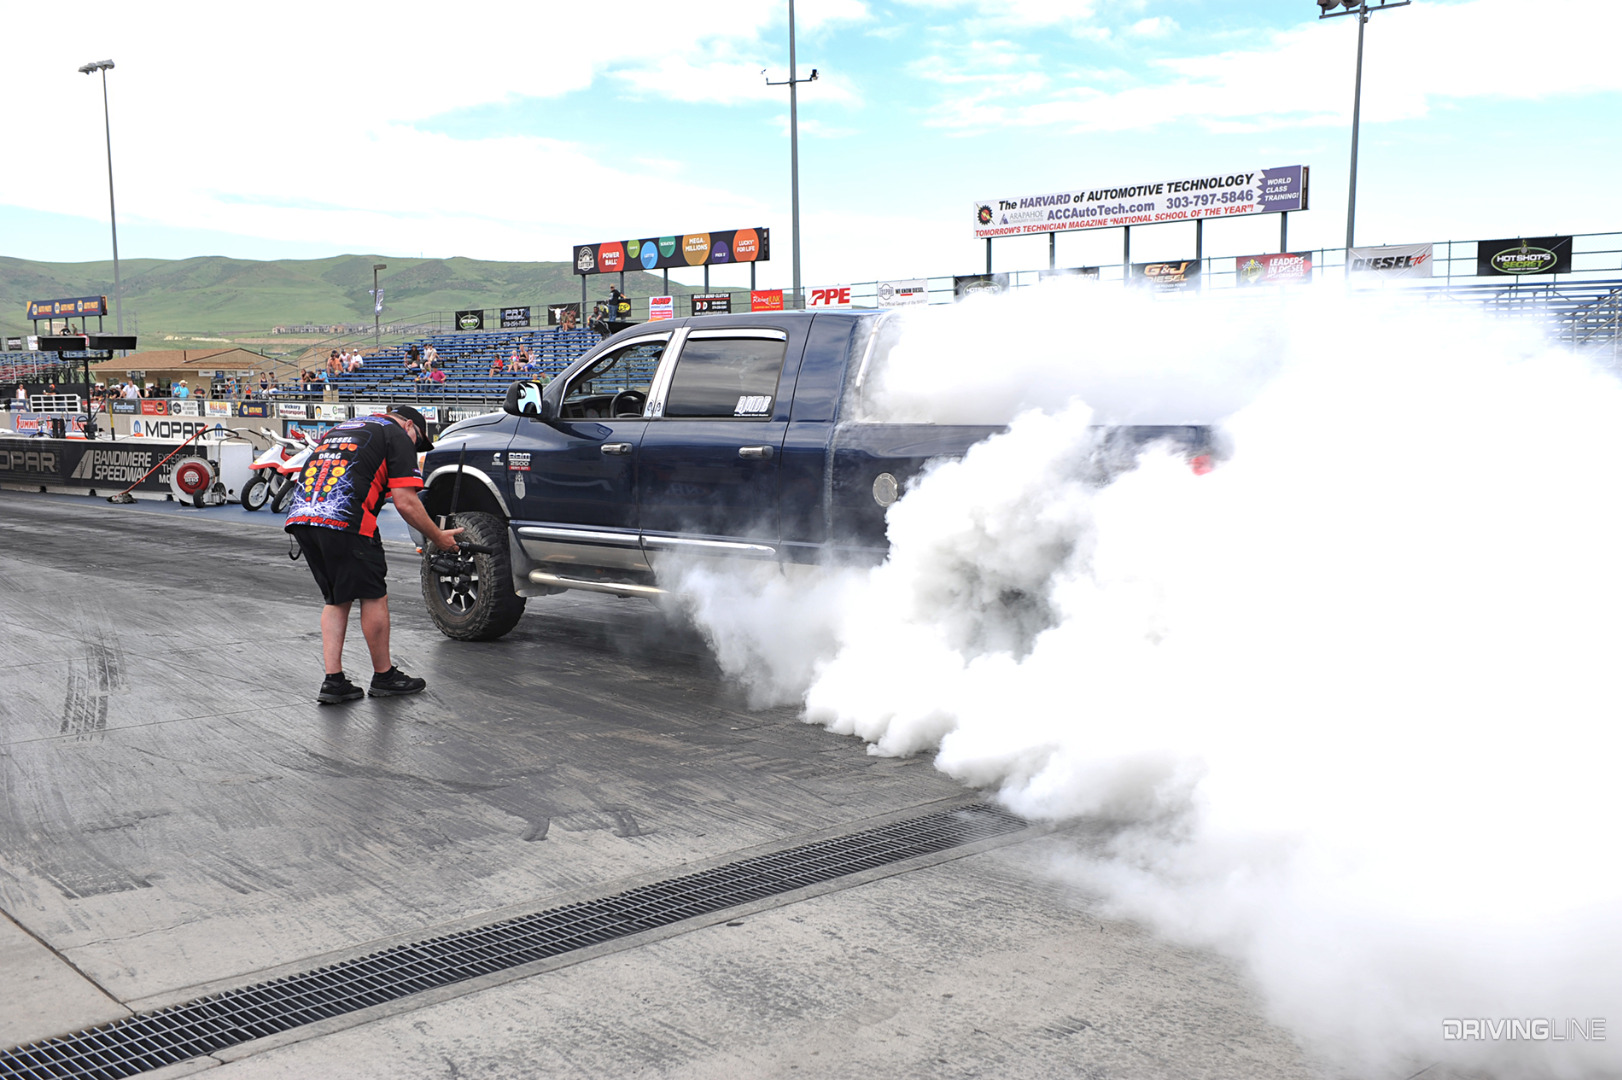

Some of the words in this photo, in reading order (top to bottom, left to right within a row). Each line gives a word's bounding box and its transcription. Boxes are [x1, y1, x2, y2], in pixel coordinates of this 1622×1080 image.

[1265, 185, 1288, 194] CLASS
[1267, 177, 1292, 186] WORLD
[999, 200, 1017, 211] The
[1020, 194, 1071, 209] HARVARD
[1074, 192, 1085, 203] of
[1087, 184, 1164, 202] AUTOMOTIVE
[1167, 173, 1254, 194] TECHNOLOGY
[1166, 190, 1254, 209] 303-797-5846
[1264, 192, 1300, 202] TRAINING!
[1047, 203, 1155, 221] ACCAutoTech.com
[976, 226, 1021, 237] TOMORROW'S
[1023, 221, 1067, 233] TECHNICIAN
[1068, 218, 1108, 230] MAGAZINE
[1155, 209, 1189, 221] SCHOOL
[1190, 207, 1203, 217] OF
[1204, 206, 1222, 216] THE
[602, 251, 620, 259] POWER
[685, 244, 708, 252] MILLIONS
[1270, 256, 1304, 265] LEADERS
[1352, 255, 1412, 271] DIESEL
[1502, 260, 1544, 268] SECRET
[1268, 265, 1277, 274] IN
[1278, 264, 1304, 273] DIESEL
[808, 287, 851, 306] PPE
[145, 421, 207, 440] MOPAR
[324, 436, 352, 444] DIESEL
[0, 450, 57, 472] OPAR
[95, 451, 152, 467] BANDIMERE
[94, 465, 149, 483] SPEEDWAY
